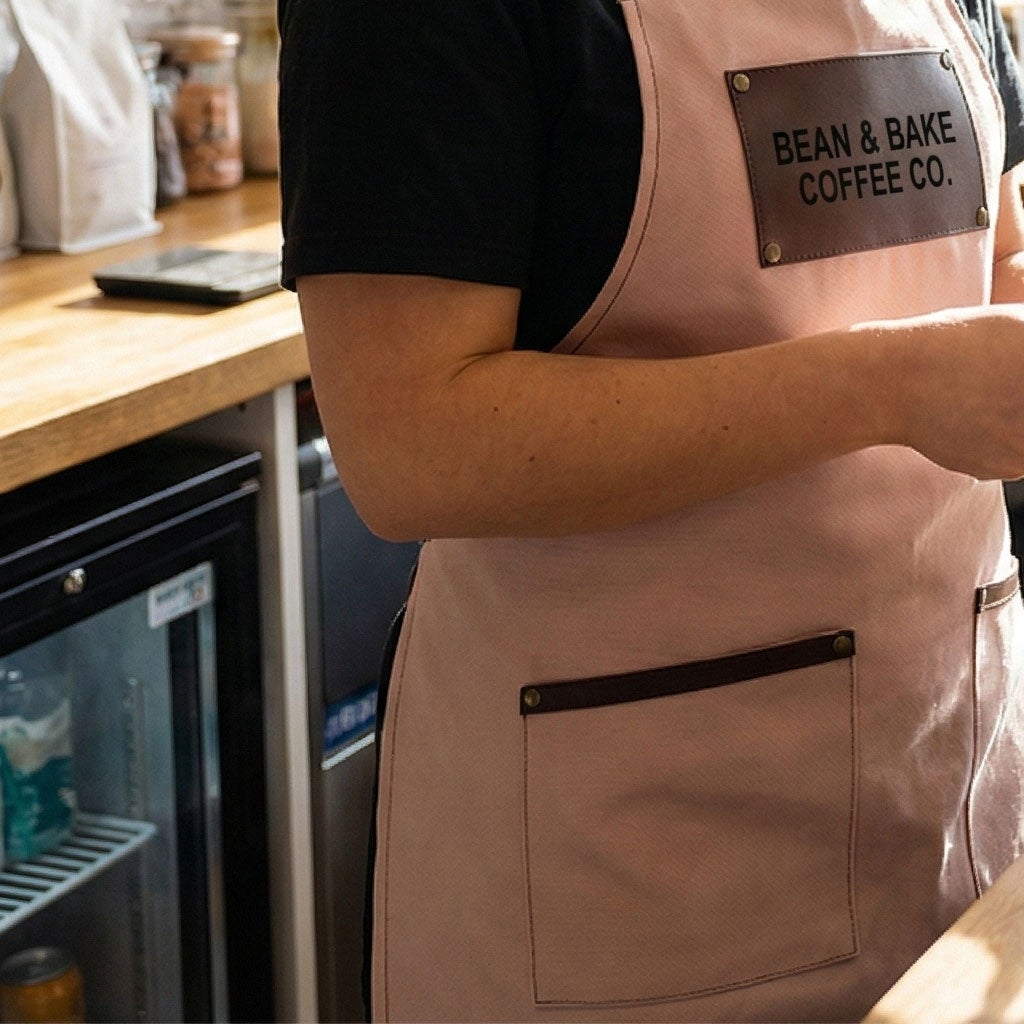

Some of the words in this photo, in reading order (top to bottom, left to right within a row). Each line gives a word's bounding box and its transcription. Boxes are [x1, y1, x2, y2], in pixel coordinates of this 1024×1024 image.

[772, 122, 852, 166] BEAN
[860, 119, 880, 155] &
[884, 110, 957, 151] BAKE
[799, 160, 904, 206] COFFEE
[909, 154, 953, 190] CO.
